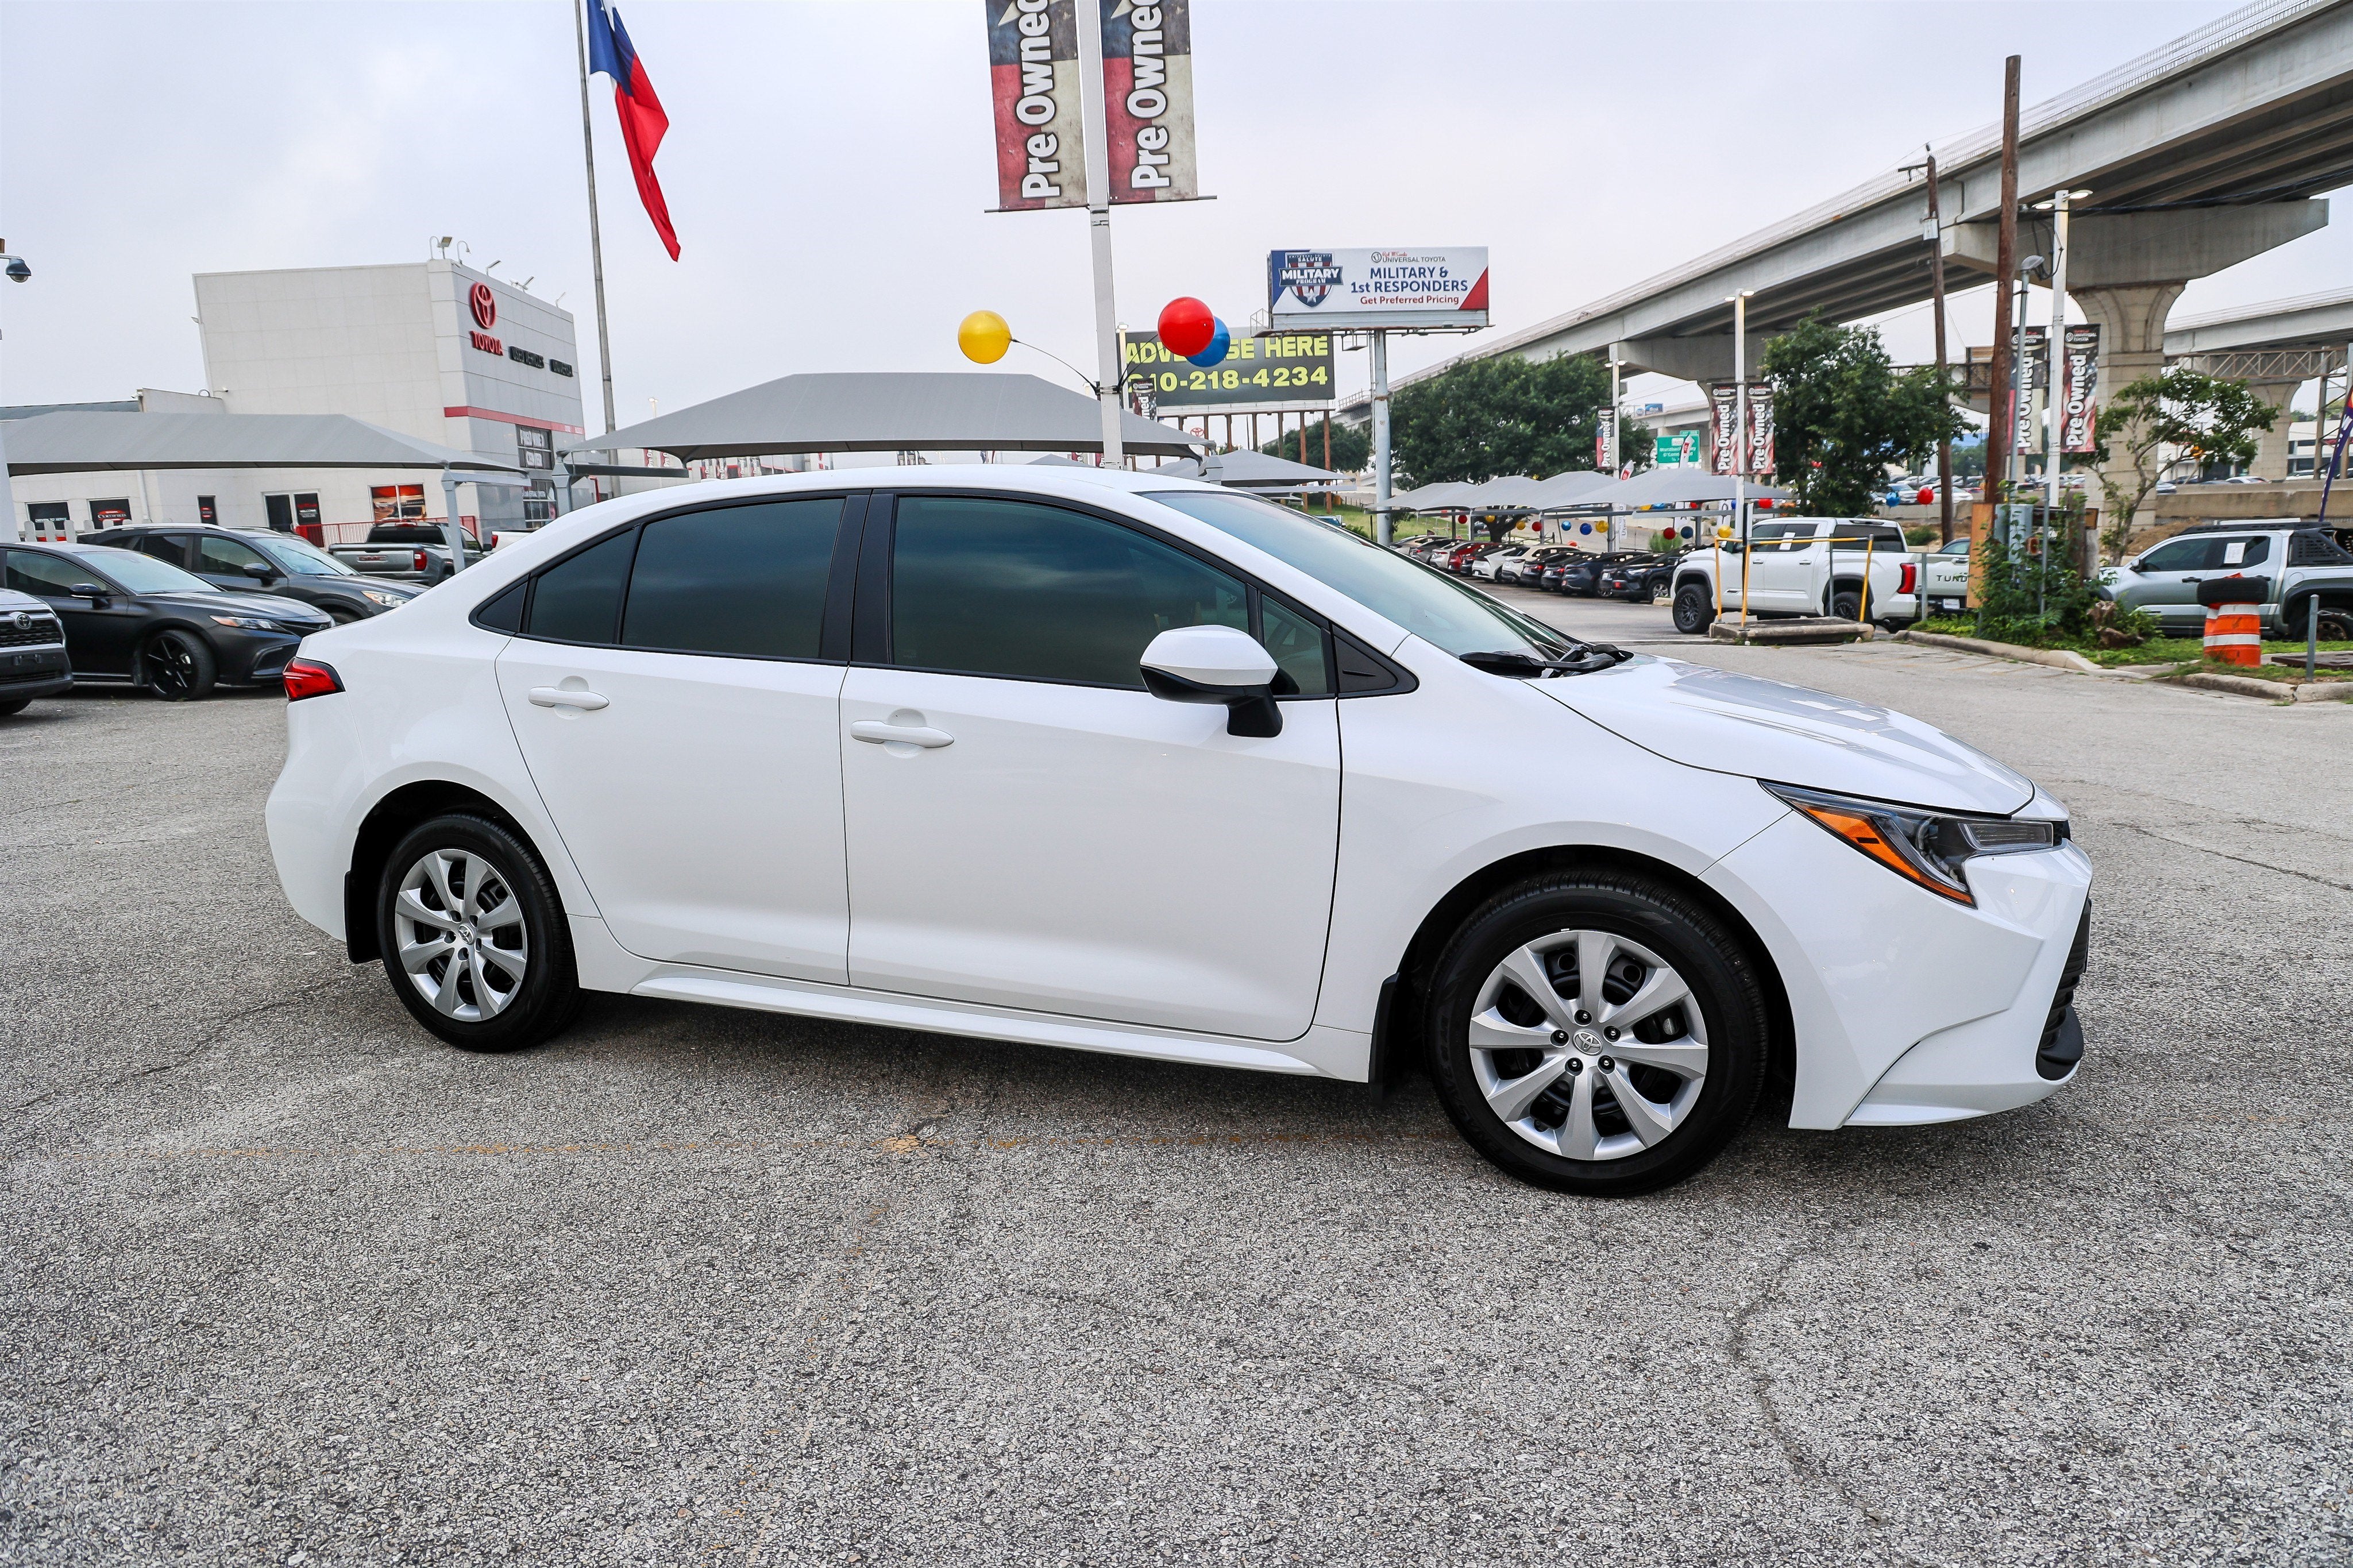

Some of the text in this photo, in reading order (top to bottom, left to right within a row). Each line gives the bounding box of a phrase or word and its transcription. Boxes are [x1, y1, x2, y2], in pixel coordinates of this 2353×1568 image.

[1127, 0, 1171, 188] Pre Owne
[1022, 133, 1060, 199] Pre
[1282, 268, 1339, 280] MILITARY
[1370, 266, 1448, 279] MILITARY &
[1351, 280, 1468, 293] 1st RESPONDERS
[1360, 295, 1459, 304] Get Preferred Pricing
[469, 330, 503, 356] TOYOTA
[510, 346, 524, 362] USED
[1126, 335, 1328, 364] ADVSE HERE
[2067, 355, 2086, 415] Owned
[1601, 421, 1611, 451] Owned
[1717, 404, 1730, 447] Owned
[1753, 404, 1766, 447] Owned
[2017, 419, 2032, 448] Pre
[2066, 417, 2084, 446] Pre
[1601, 452, 1611, 467] Pre
[1718, 449, 1730, 470] Pre
[1753, 449, 1766, 470] Pre
